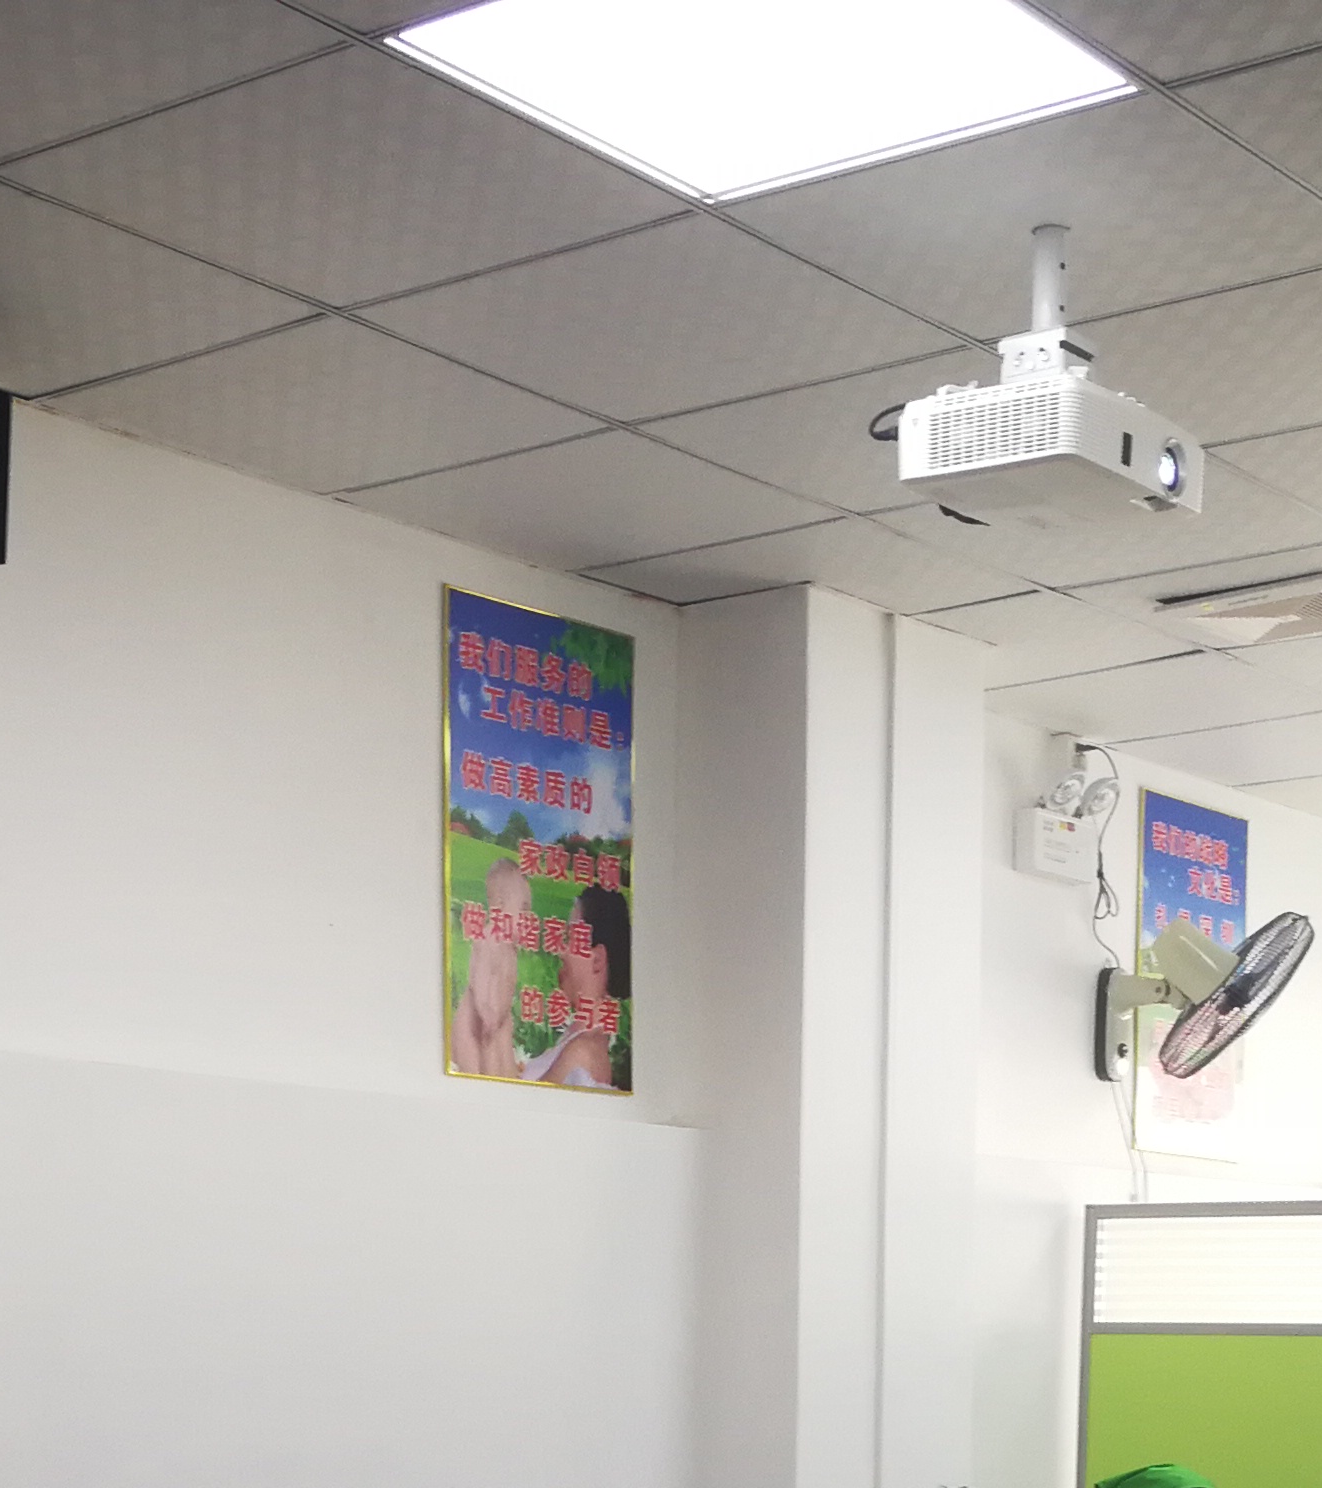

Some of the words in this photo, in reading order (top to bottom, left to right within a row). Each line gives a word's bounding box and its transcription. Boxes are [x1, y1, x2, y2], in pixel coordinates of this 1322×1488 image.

[458, 632, 594, 701] 我们服务的
[460, 750, 594, 814] 做高素质的
[461, 901, 594, 959] 做和谐家庭
[519, 985, 621, 1034] 的参与者
